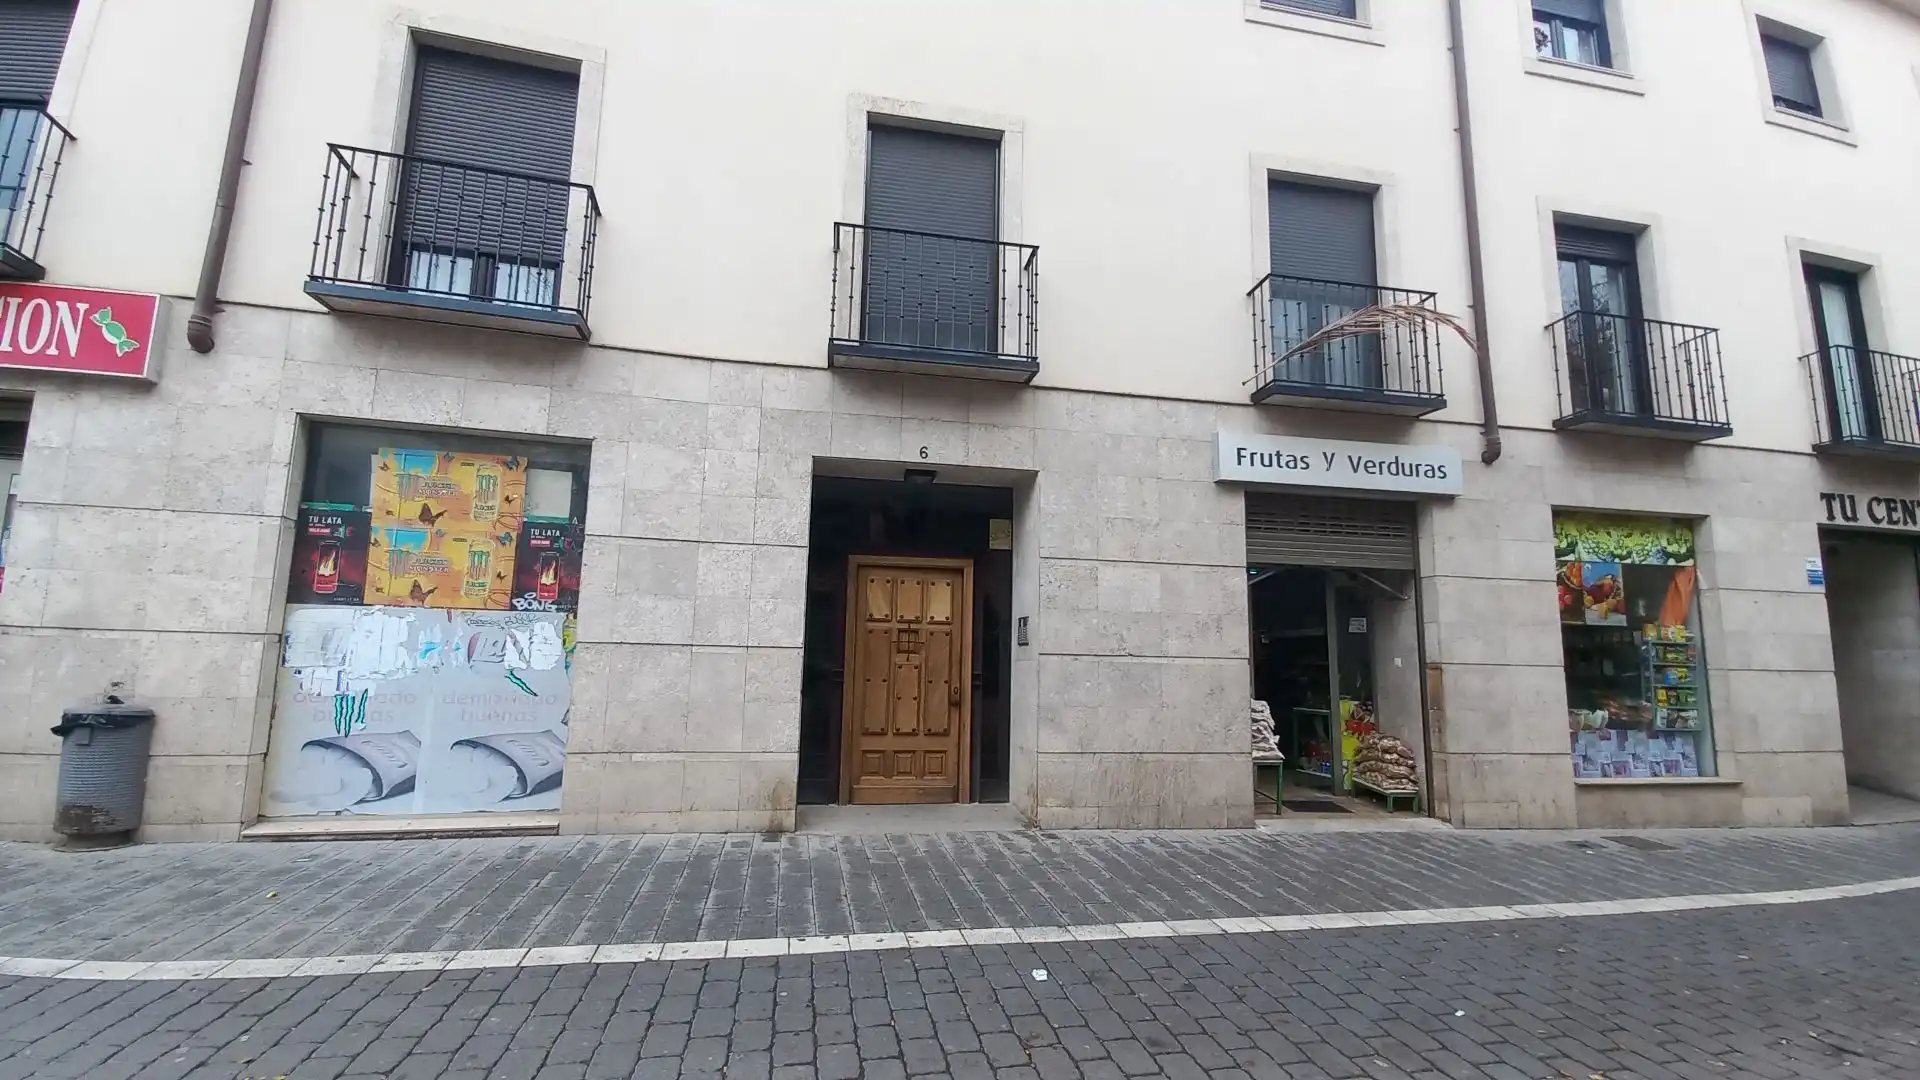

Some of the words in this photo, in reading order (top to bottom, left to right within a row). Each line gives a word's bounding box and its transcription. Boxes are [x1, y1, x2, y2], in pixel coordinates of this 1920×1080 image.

[0, 296, 90, 358] ION
[919, 446, 929, 459] 6
[1236, 447, 1310, 470] Frutas
[1347, 455, 1447, 480] Verduras
[308, 515, 319, 523] TU
[321, 516, 342, 525] LATA
[1820, 492, 1859, 523] TU
[1867, 496, 1920, 527] CEN
[530, 528, 540, 536] TU
[542, 529, 561, 537] LATA
